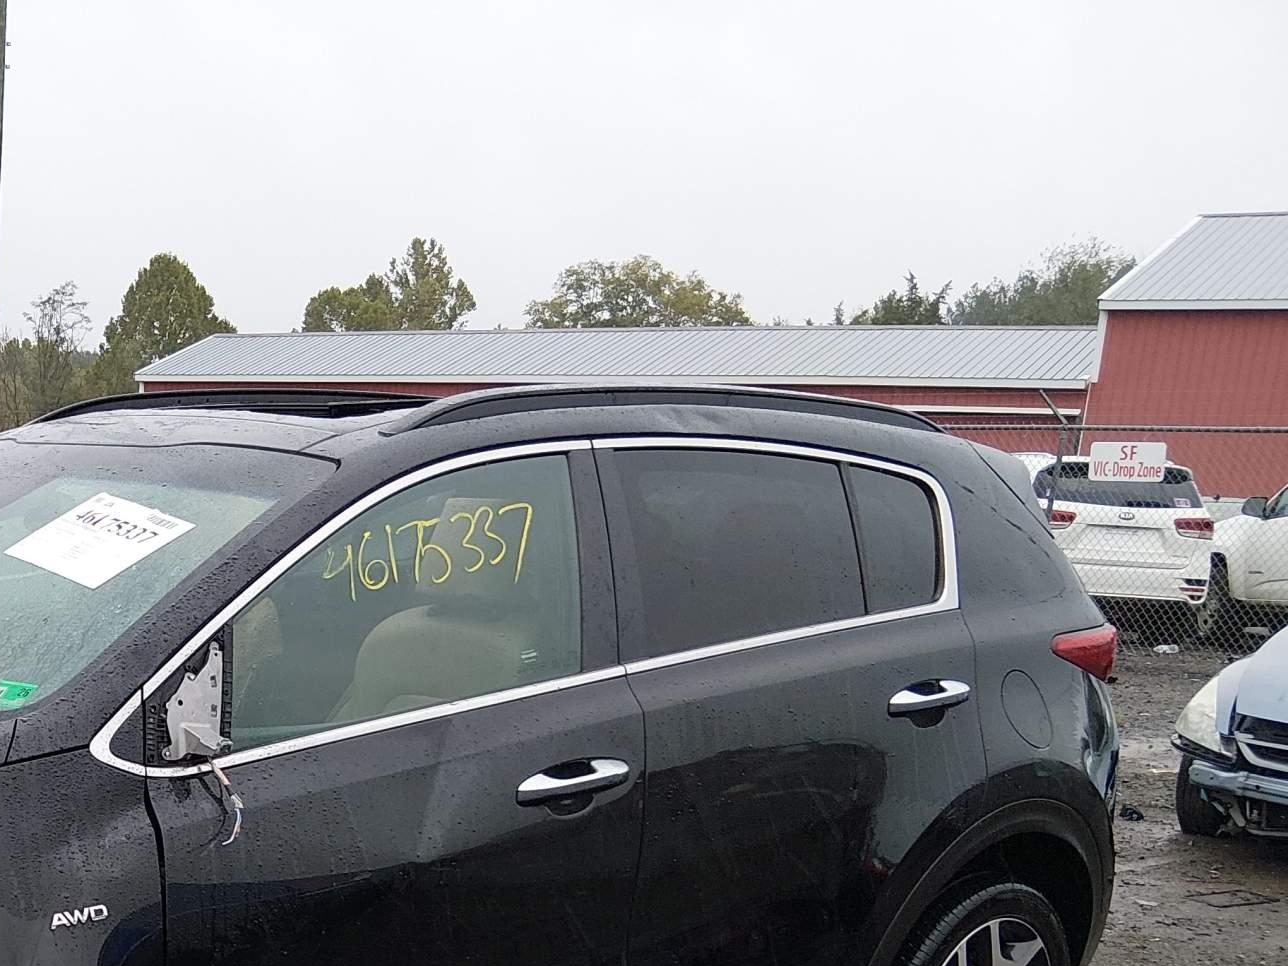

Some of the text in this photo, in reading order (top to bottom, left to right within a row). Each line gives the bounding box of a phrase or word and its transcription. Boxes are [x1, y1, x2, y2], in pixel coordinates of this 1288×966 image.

[1120, 445, 1138, 461] SF
[1093, 461, 1162, 479] VIC-Drop Zone
[321, 502, 534, 602] 46175337
[51, 904, 109, 930] AWD
